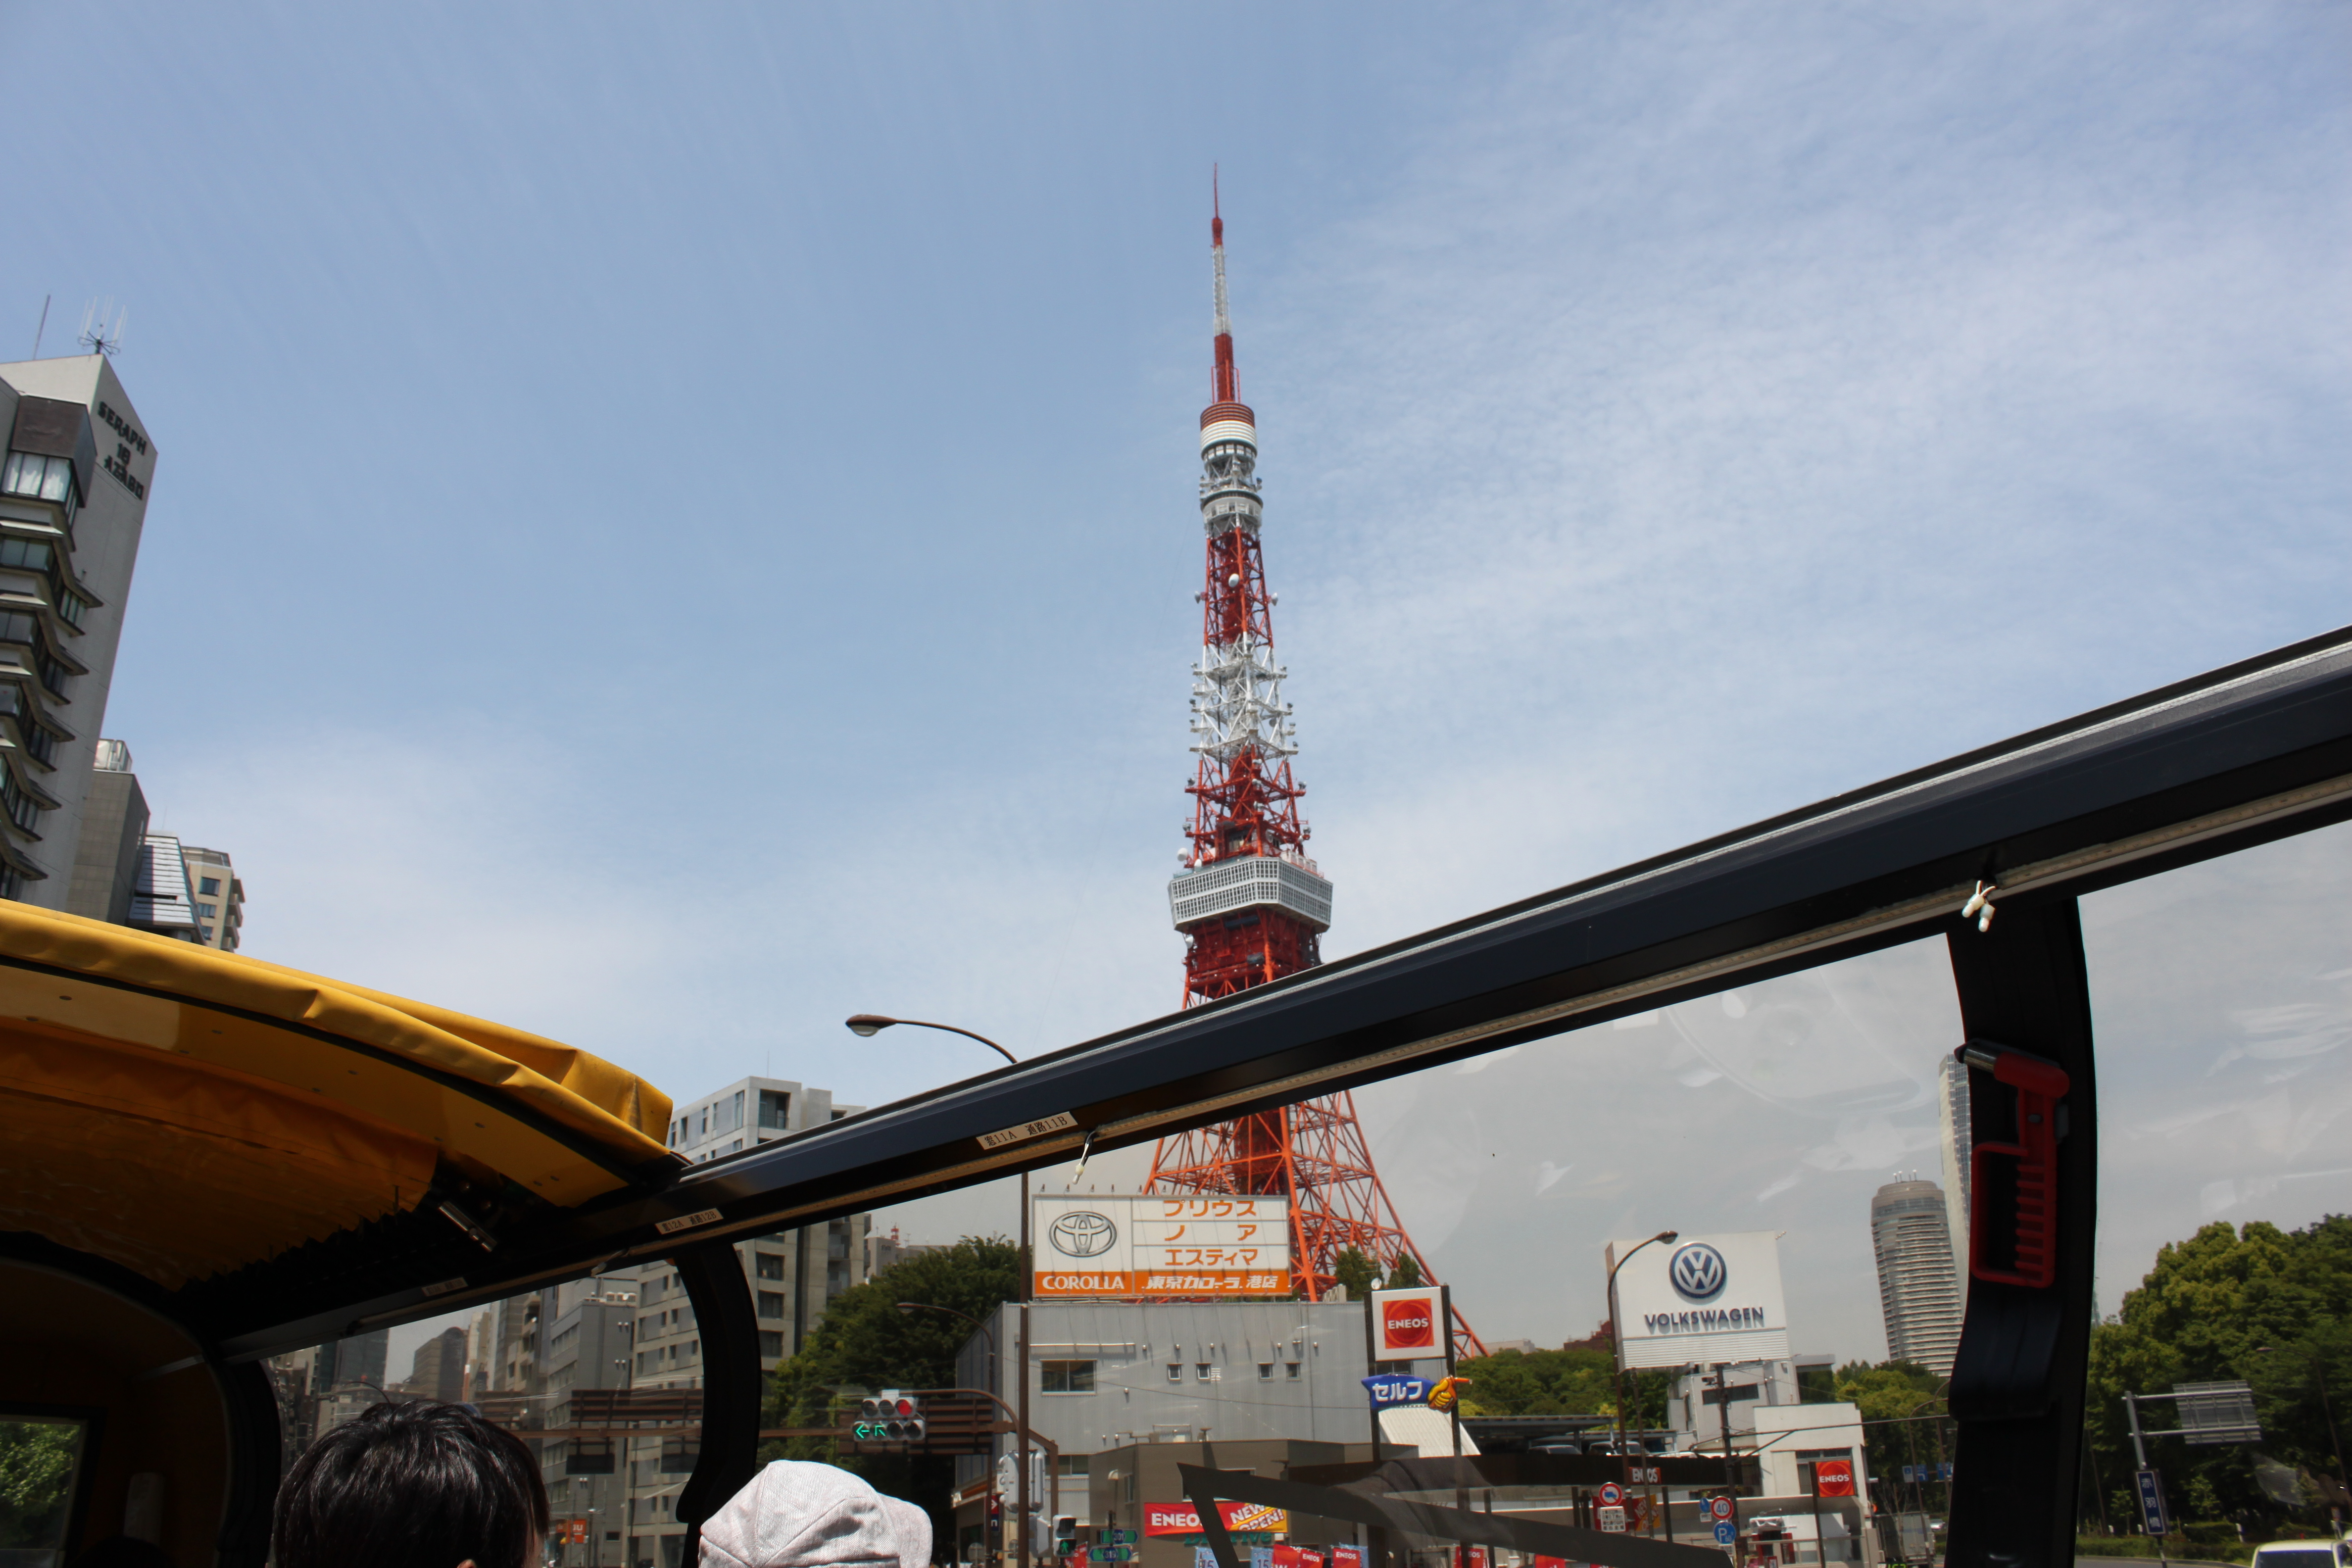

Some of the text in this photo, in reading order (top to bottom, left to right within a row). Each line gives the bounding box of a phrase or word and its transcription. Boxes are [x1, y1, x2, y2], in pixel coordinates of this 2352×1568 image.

[98, 400, 147, 456] SERAPH
[1025, 1116, 1068, 1135] 通路11B
[1164, 1199, 1257, 1217] プリウス
[1165, 1248, 1258, 1266] エスティマ
[1042, 1275, 1125, 1289] COROLLA
[1246, 1275, 1278, 1288] 港店
[1388, 1318, 1429, 1329] ENEOS
[1645, 1307, 1764, 1326] VOLKSWAGEN
[1372, 1381, 1422, 1401] セルフ
[1632, 1468, 1658, 1483] ENOS
[1819, 1474, 1850, 1483] ENEOS
[1230, 1504, 1265, 1524] NEW
[1717, 1503, 1728, 1513] 40
[1151, 1513, 1203, 1526] ENEO
[1238, 1508, 1284, 1531] OPEN!
[1104, 1550, 1116, 1559] 319
[1303, 1553, 1320, 1562] ENEOS
